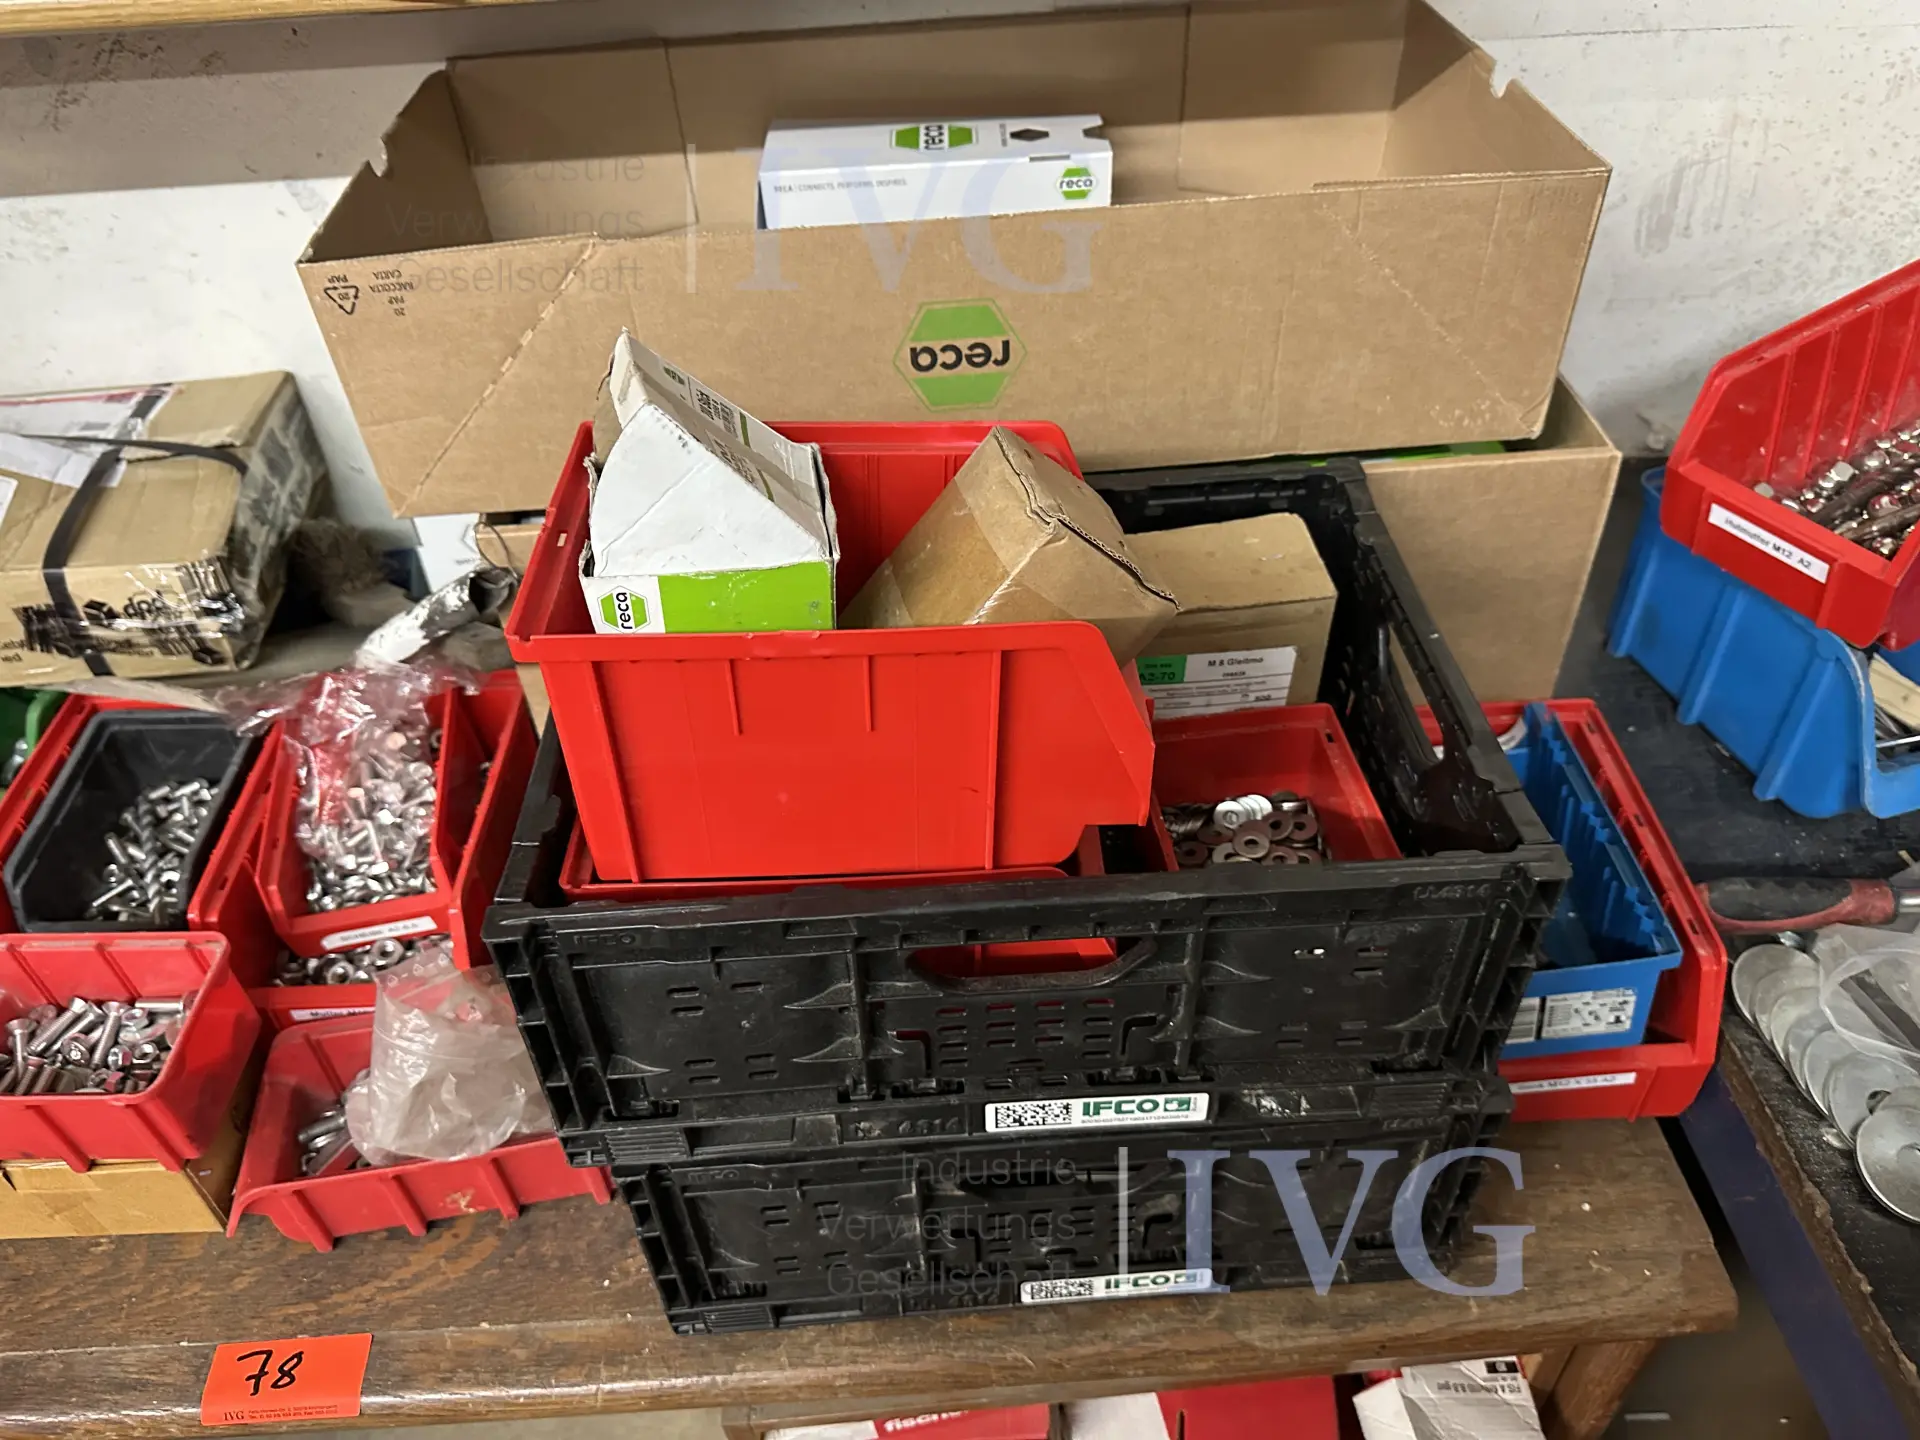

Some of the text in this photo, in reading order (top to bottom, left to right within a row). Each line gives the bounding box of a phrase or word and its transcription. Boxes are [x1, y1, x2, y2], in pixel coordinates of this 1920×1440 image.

[924, 124, 945, 150] reca
[1060, 177, 1093, 188] reca
[327, 274, 349, 284] PAP
[372, 269, 402, 280] CARTA
[367, 281, 414, 293] RACCOLTA
[909, 340, 1011, 373] reca
[1797, 558, 1812, 570] A2
[616, 592, 633, 630] reca
[1082, 1098, 1160, 1117] IFCO
[1104, 1274, 1170, 1290] IFCO
[236, 1349, 305, 1396] 78
[224, 1411, 244, 1421] IVG
[884, 1410, 969, 1433] fisc
